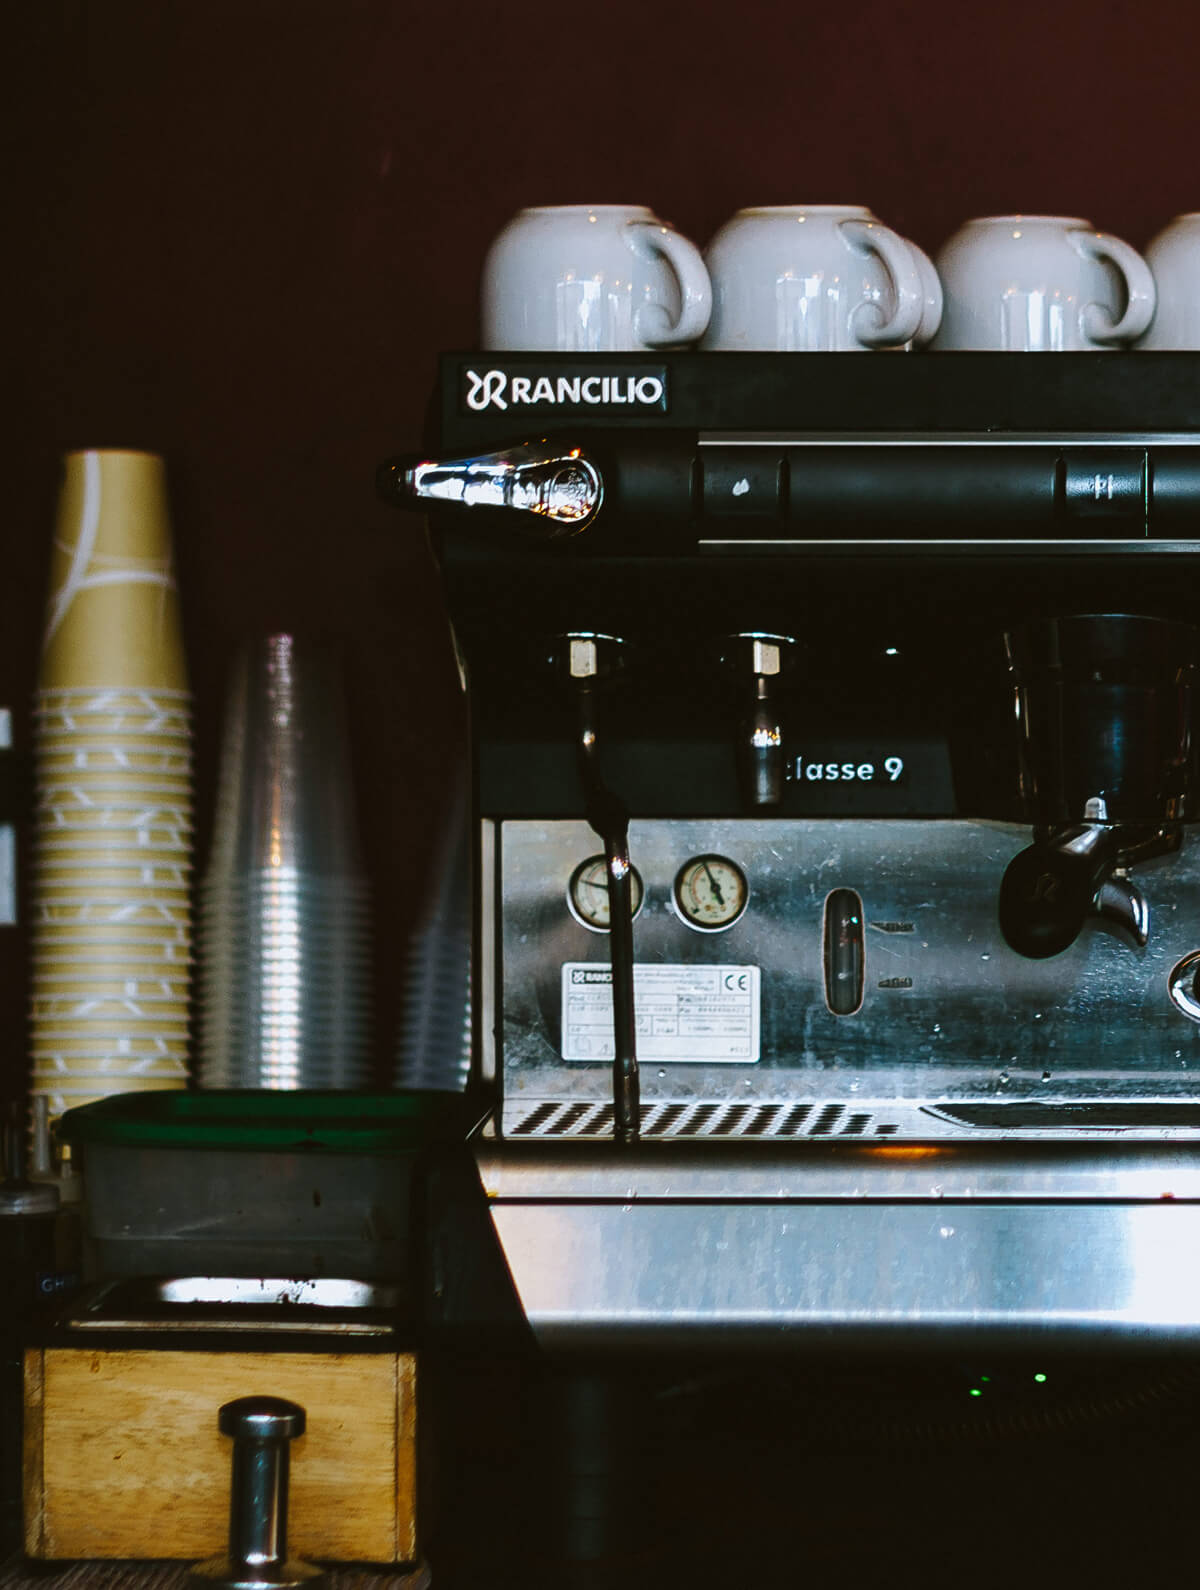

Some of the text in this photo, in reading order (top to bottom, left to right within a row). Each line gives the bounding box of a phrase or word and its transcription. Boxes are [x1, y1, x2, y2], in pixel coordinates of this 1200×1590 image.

[511, 376, 663, 404] RANCILIO
[786, 756, 904, 781] lasse 9
